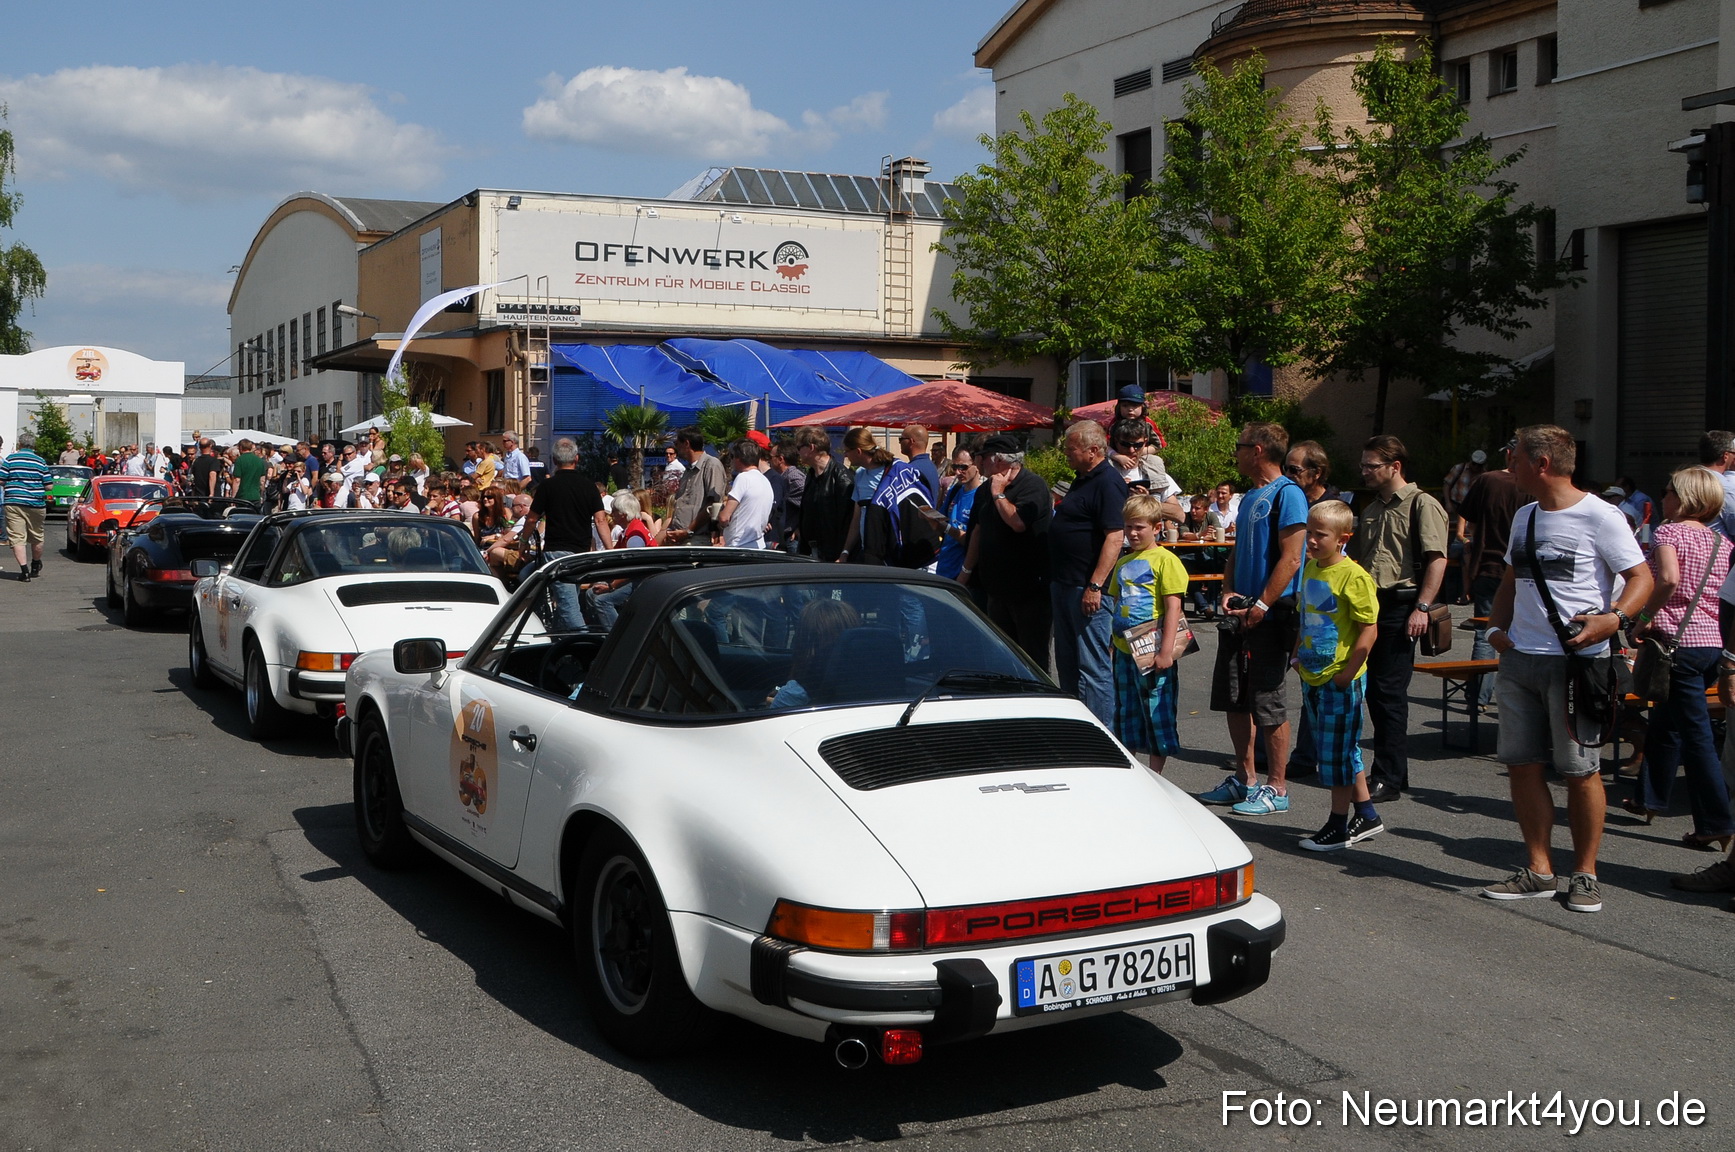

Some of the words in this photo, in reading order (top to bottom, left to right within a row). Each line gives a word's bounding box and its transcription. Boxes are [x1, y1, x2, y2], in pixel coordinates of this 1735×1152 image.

[575, 241, 770, 271] OFENWERK
[503, 314, 576, 322] HAUPTEINGANG
[469, 703, 486, 732] 20
[967, 890, 1190, 934] PORSCHE
[1039, 964, 1057, 999] A
[1079, 957, 1097, 993] G
[1104, 943, 1191, 988] 7826H
[1023, 988, 1031, 999] D
[1043, 1001, 1072, 1012] Bobingen
